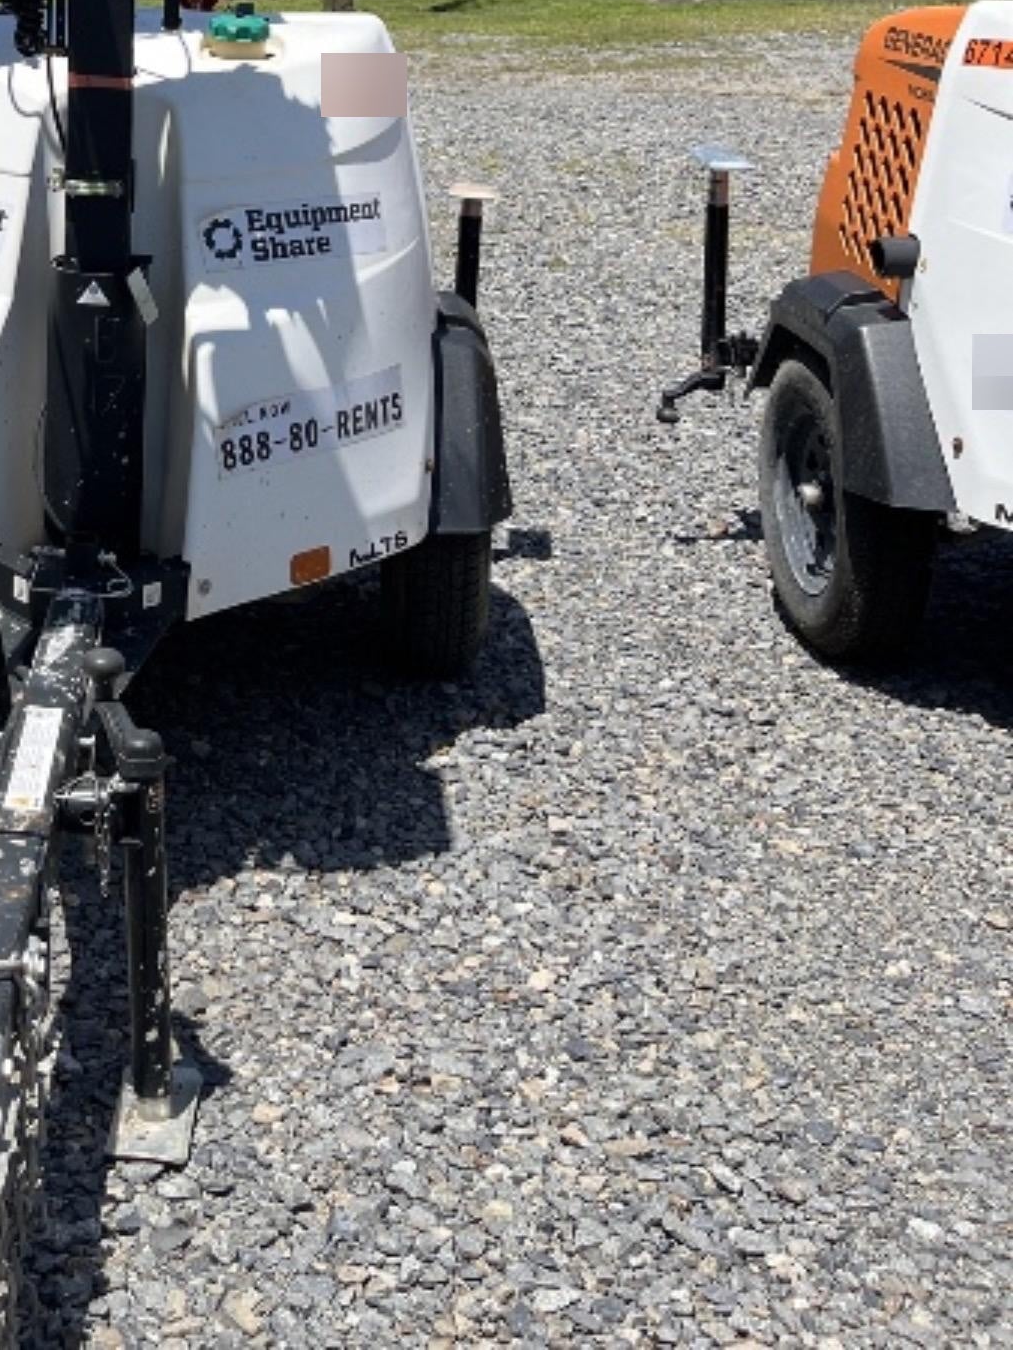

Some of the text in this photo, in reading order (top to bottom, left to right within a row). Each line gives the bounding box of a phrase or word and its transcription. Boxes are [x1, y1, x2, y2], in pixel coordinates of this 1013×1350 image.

[245, 198, 380, 232] Equipment
[251, 236, 331, 261] Share
[221, 392, 403, 470] 888-80-RENTS
